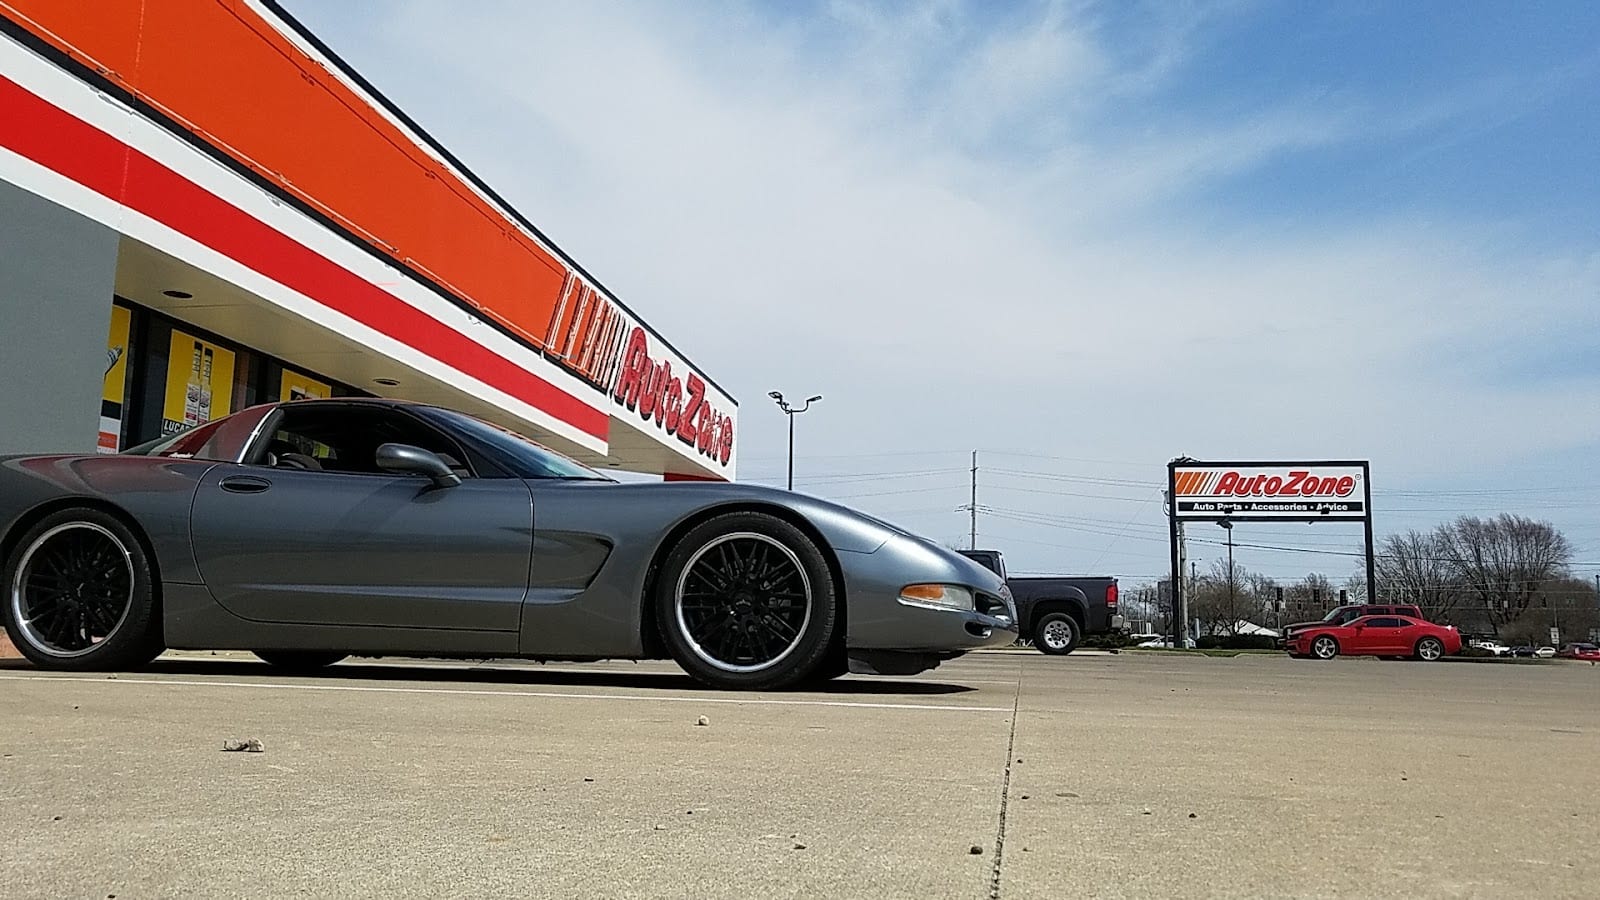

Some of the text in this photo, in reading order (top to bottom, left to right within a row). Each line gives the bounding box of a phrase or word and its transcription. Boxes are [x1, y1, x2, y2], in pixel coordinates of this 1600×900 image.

[614, 326, 733, 465] AutoZone
[1213, 471, 1355, 496] AutoZone
[1193, 502, 1215, 511] Auto
[1251, 502, 1308, 511] Accessories
